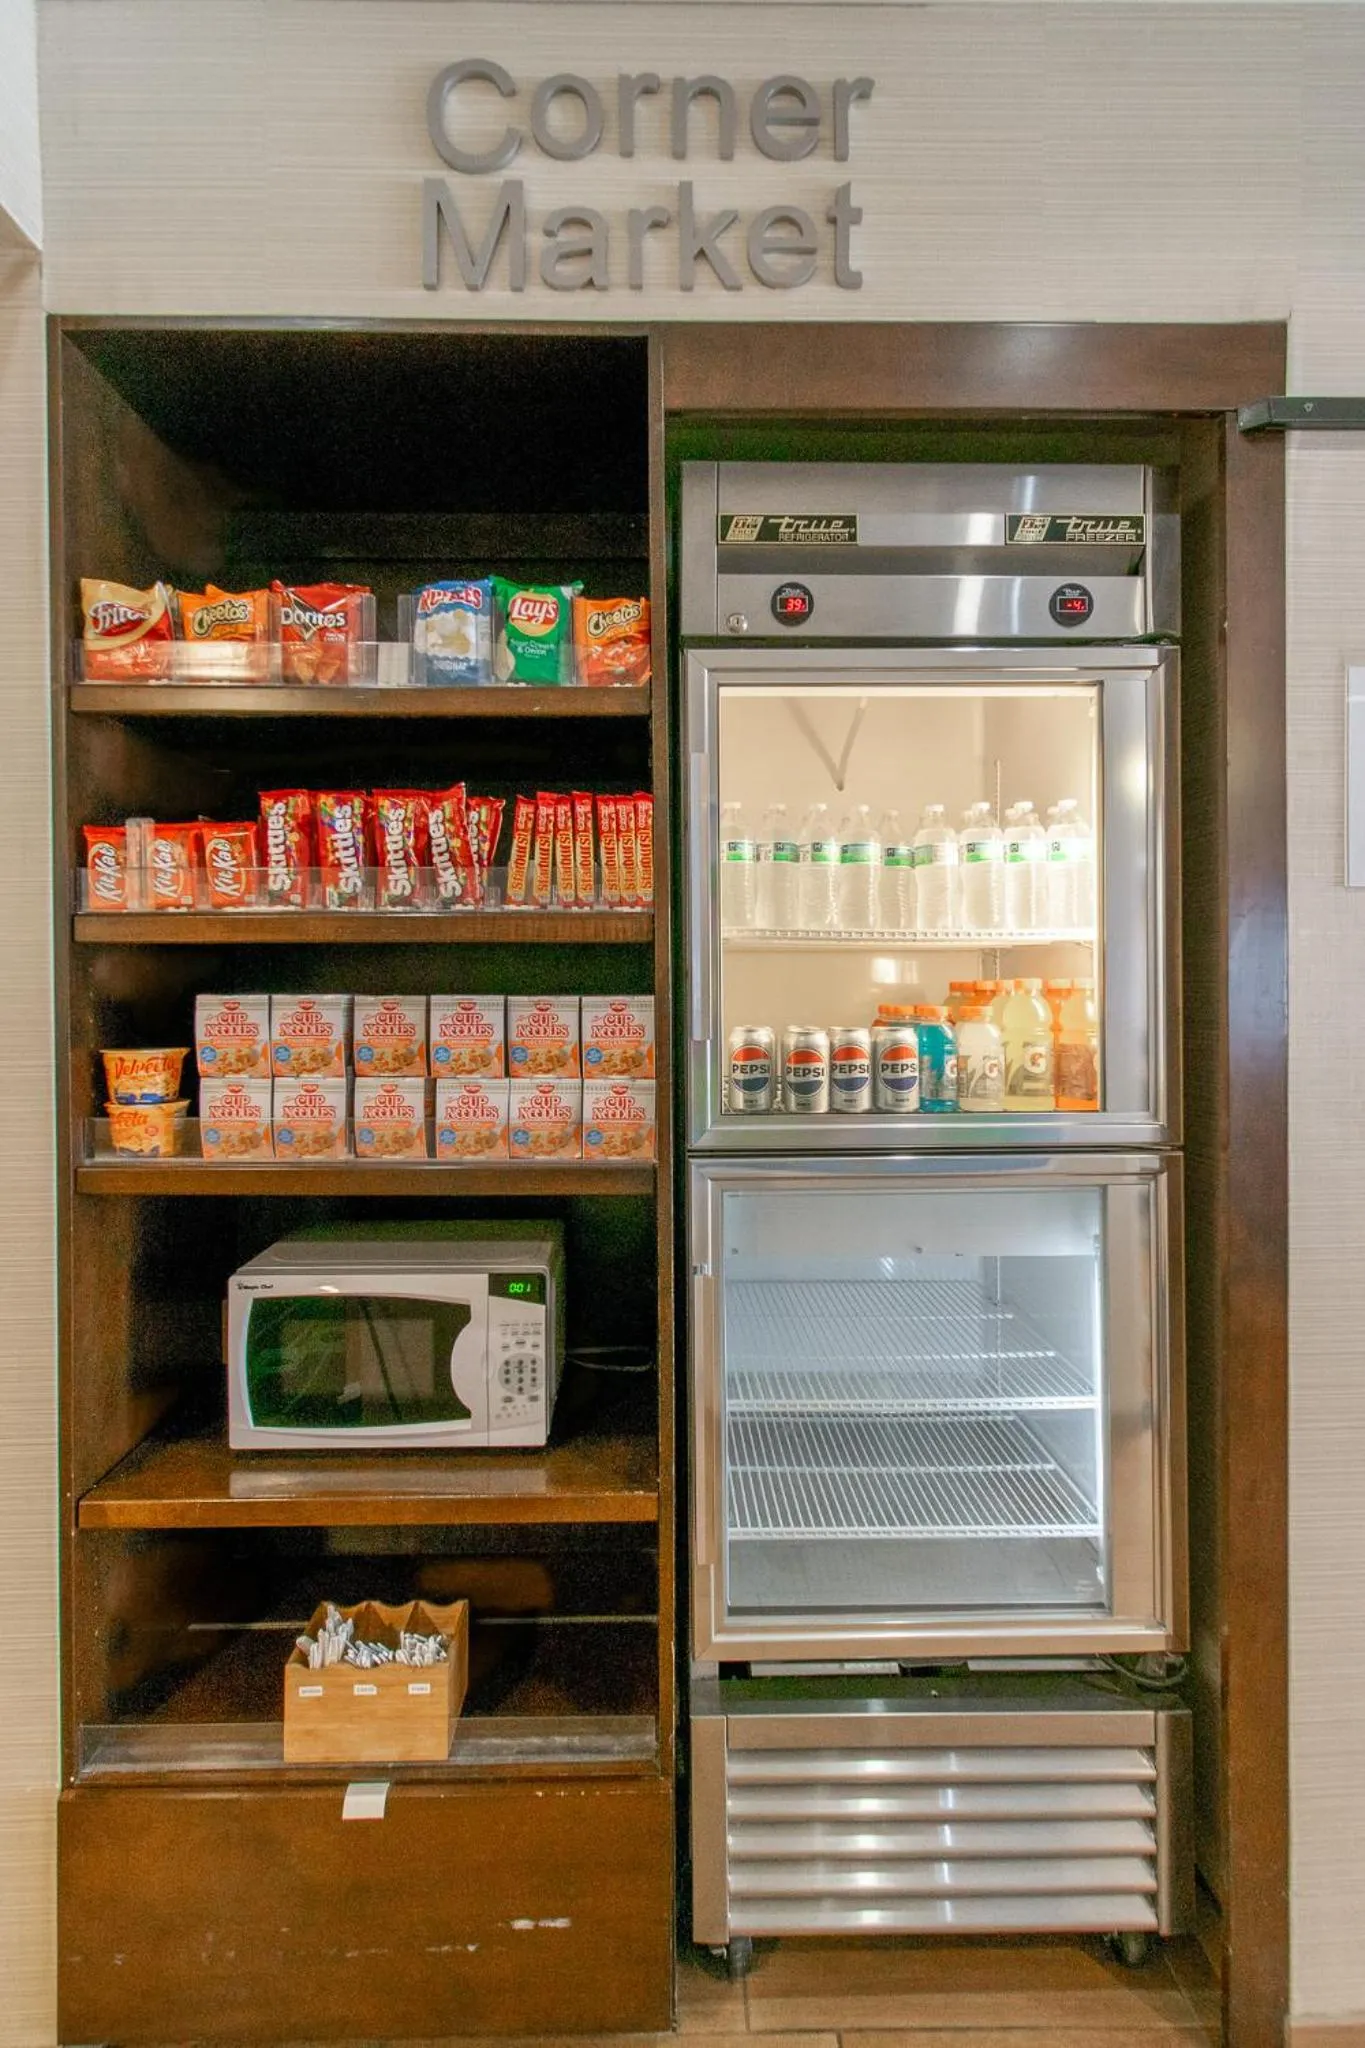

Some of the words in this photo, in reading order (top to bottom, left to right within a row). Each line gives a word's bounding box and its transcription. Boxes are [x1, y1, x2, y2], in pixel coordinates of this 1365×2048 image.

[426, 58, 875, 174] Corner
[423, 178, 863, 292] Market
[779, 532, 848, 541] REFRIGERATOR
[1066, 533, 1136, 541] FREEZER
[193, 600, 249, 635] Cheetos
[281, 607, 345, 627] Doritos
[588, 603, 642, 637] Cheetos
[332, 804, 362, 893] Skittles
[388, 808, 412, 897] Skittles
[428, 810, 462, 897] Skittles
[217, 1012, 248, 1024] CUP
[292, 1012, 322, 1024] CUP
[375, 1013, 406, 1025] CUP
[452, 1013, 483, 1025] CUP
[528, 1013, 558, 1026] CUP
[603, 1013, 634, 1026] CUP
[204, 1024, 259, 1036] NOODLES
[280, 1023, 333, 1036] NOODLES
[363, 1024, 415, 1036] NOODLES
[440, 1024, 494, 1037] NOODLES
[516, 1025, 569, 1038] NOODLES
[591, 1025, 645, 1038] NOODLES
[786, 1067, 824, 1077] PEPSI
[829, 1064, 869, 1074] PEPSI
[881, 1063, 917, 1073] PEPS
[221, 1095, 251, 1106] CUP
[295, 1095, 325, 1106] CUP
[375, 1095, 404, 1106] CUP
[458, 1095, 488, 1107] CUP
[530, 1096, 561, 1108] CUP
[605, 1096, 635, 1108] CUP
[209, 1106, 261, 1118] NOODLES
[283, 1106, 336, 1118] NOODLES
[363, 1106, 415, 1118] NOODLES
[445, 1106, 499, 1119] NOODLES
[518, 1107, 572, 1119] NOODLES
[592, 1107, 646, 1120] NOODLES
